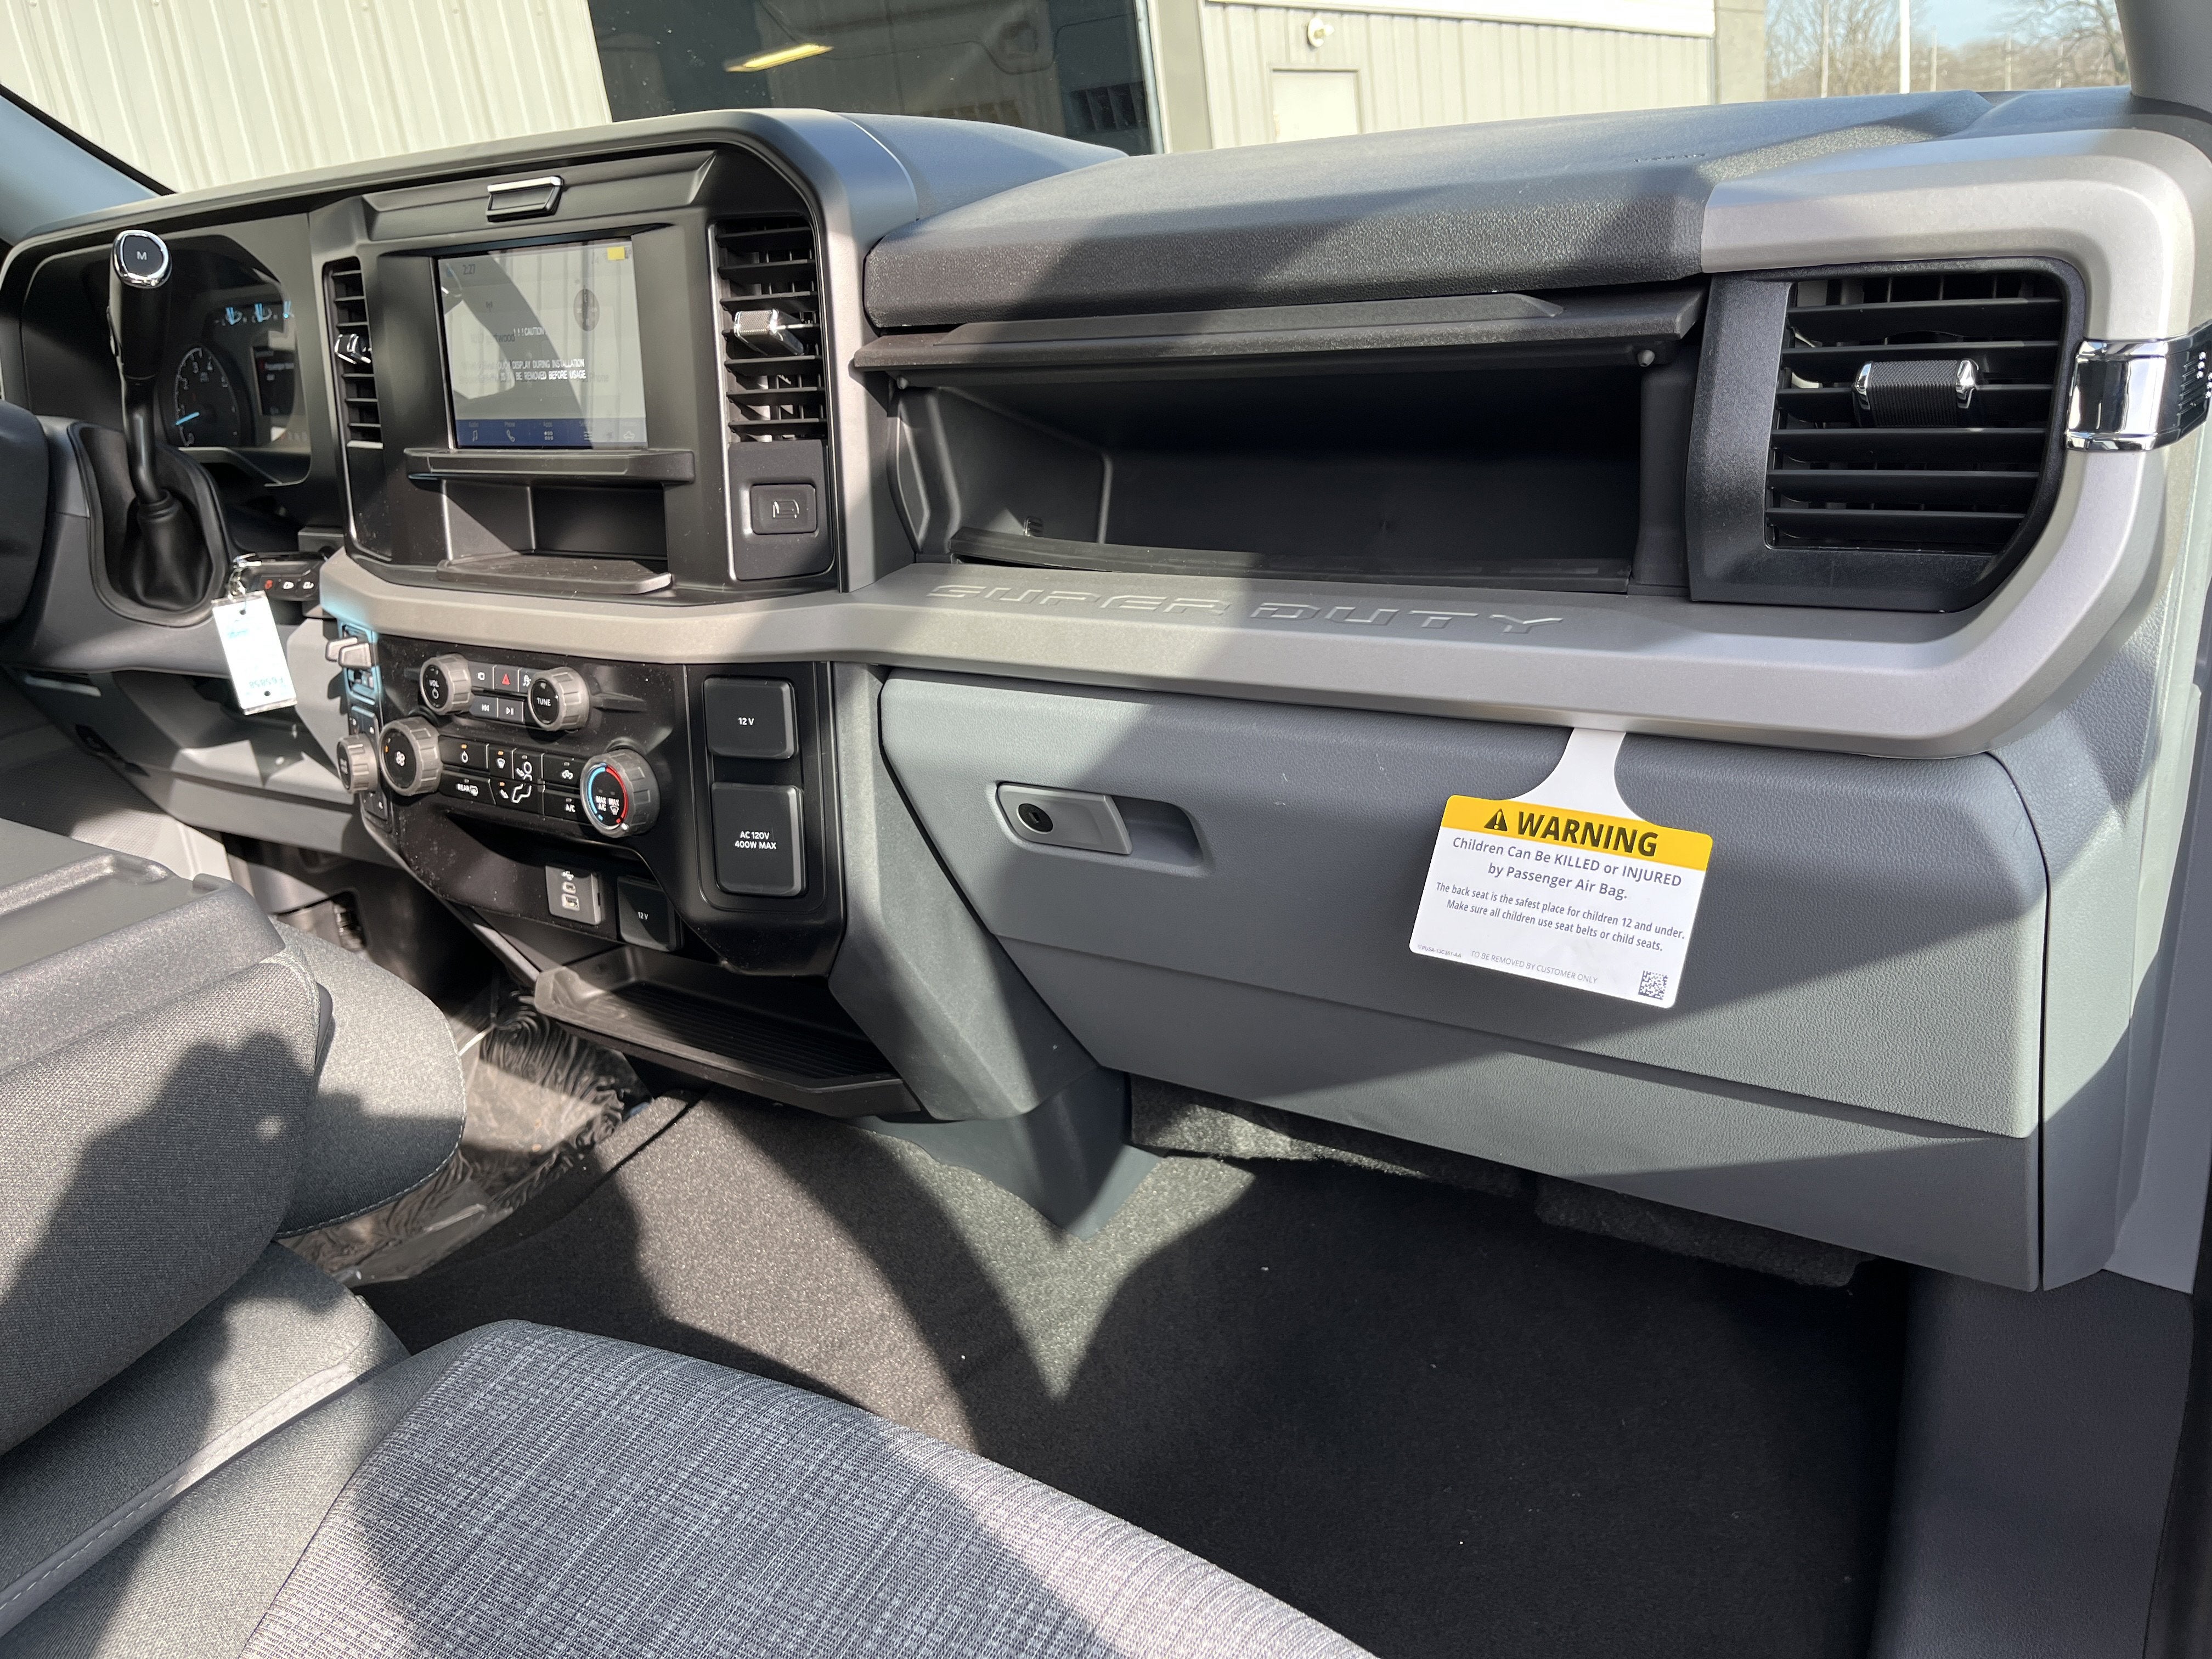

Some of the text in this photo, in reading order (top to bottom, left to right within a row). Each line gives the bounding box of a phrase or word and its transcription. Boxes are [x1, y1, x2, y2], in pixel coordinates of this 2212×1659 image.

[137, 251, 147, 261] M
[551, 359, 585, 368] INSTALLATION
[524, 371, 546, 380] REMOVED
[549, 370, 568, 380] BEFORE
[569, 369, 586, 379] USAGE
[926, 585, 1564, 634] SUPER DUTY
[429, 679, 439, 687] VOL
[537, 697, 551, 707] TUNE
[738, 717, 754, 726] 12 V
[596, 795, 619, 806] MAX MAX
[566, 804, 575, 812] A/C
[598, 803, 606, 811] A/C
[751, 832, 770, 840] 120V
[1518, 811, 1658, 857] WARNING
[735, 840, 757, 849] 400W
[1453, 837, 1681, 886] Children Can Be KILLED or INJURED
[1488, 862, 1627, 900] by Passenger Air Bag.
[1436, 882, 1685, 939] The back seat is the safest place for children 12 and under.
[1447, 899, 1663, 951] Make sure all children use seat belts or child seats.
[1491, 955, 1525, 968] REMOVED
[1537, 965, 1576, 979] CUSTOMER
[1577, 974, 1598, 984] ONLY
